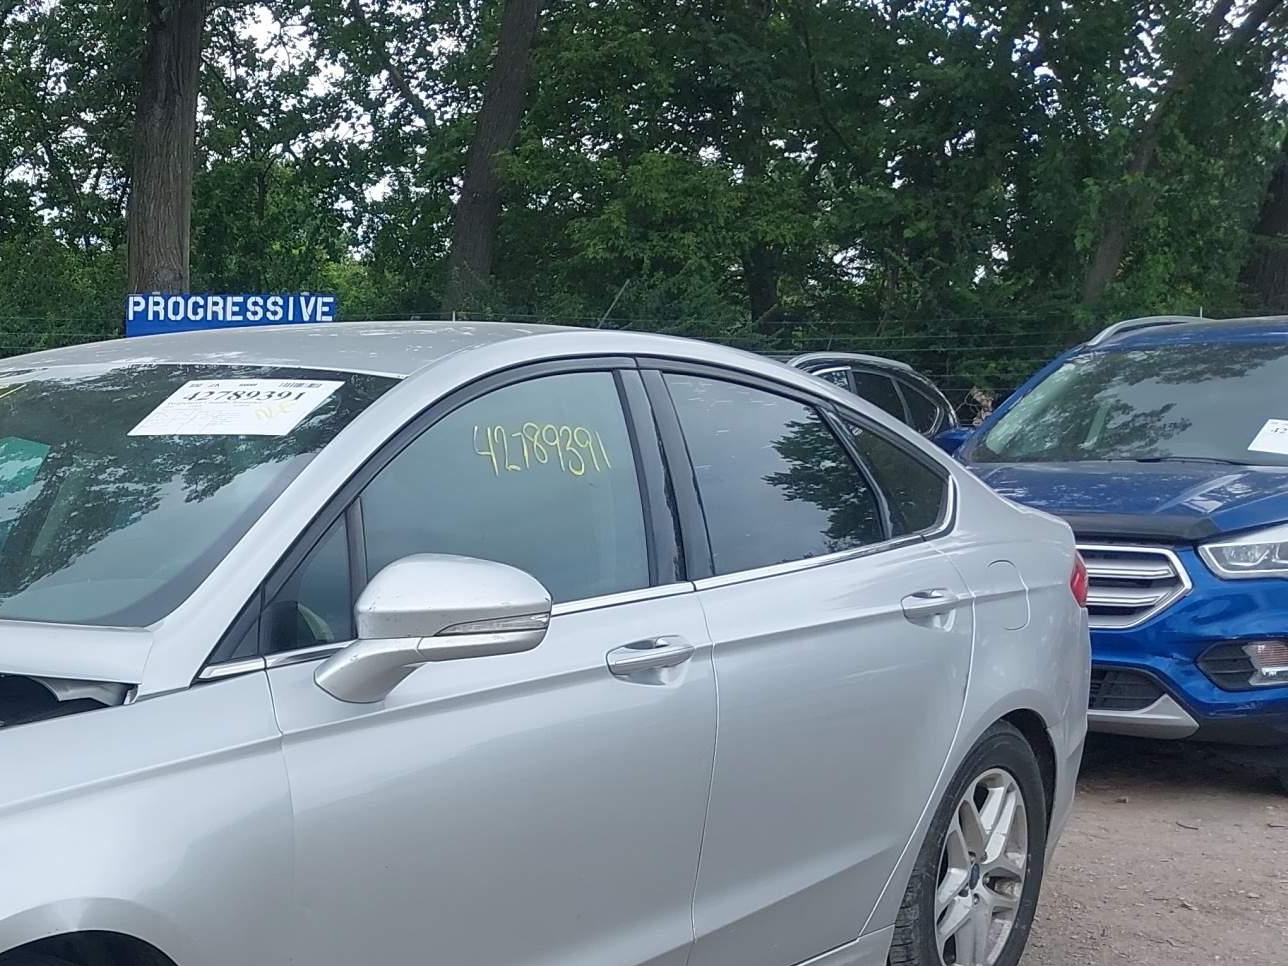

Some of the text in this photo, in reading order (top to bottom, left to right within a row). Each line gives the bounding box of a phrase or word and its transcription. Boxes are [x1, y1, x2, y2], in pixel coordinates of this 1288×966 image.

[128, 296, 334, 321] PROGRESSIVE
[183, 391, 306, 401] 42789391
[473, 422, 612, 476] 42789391
